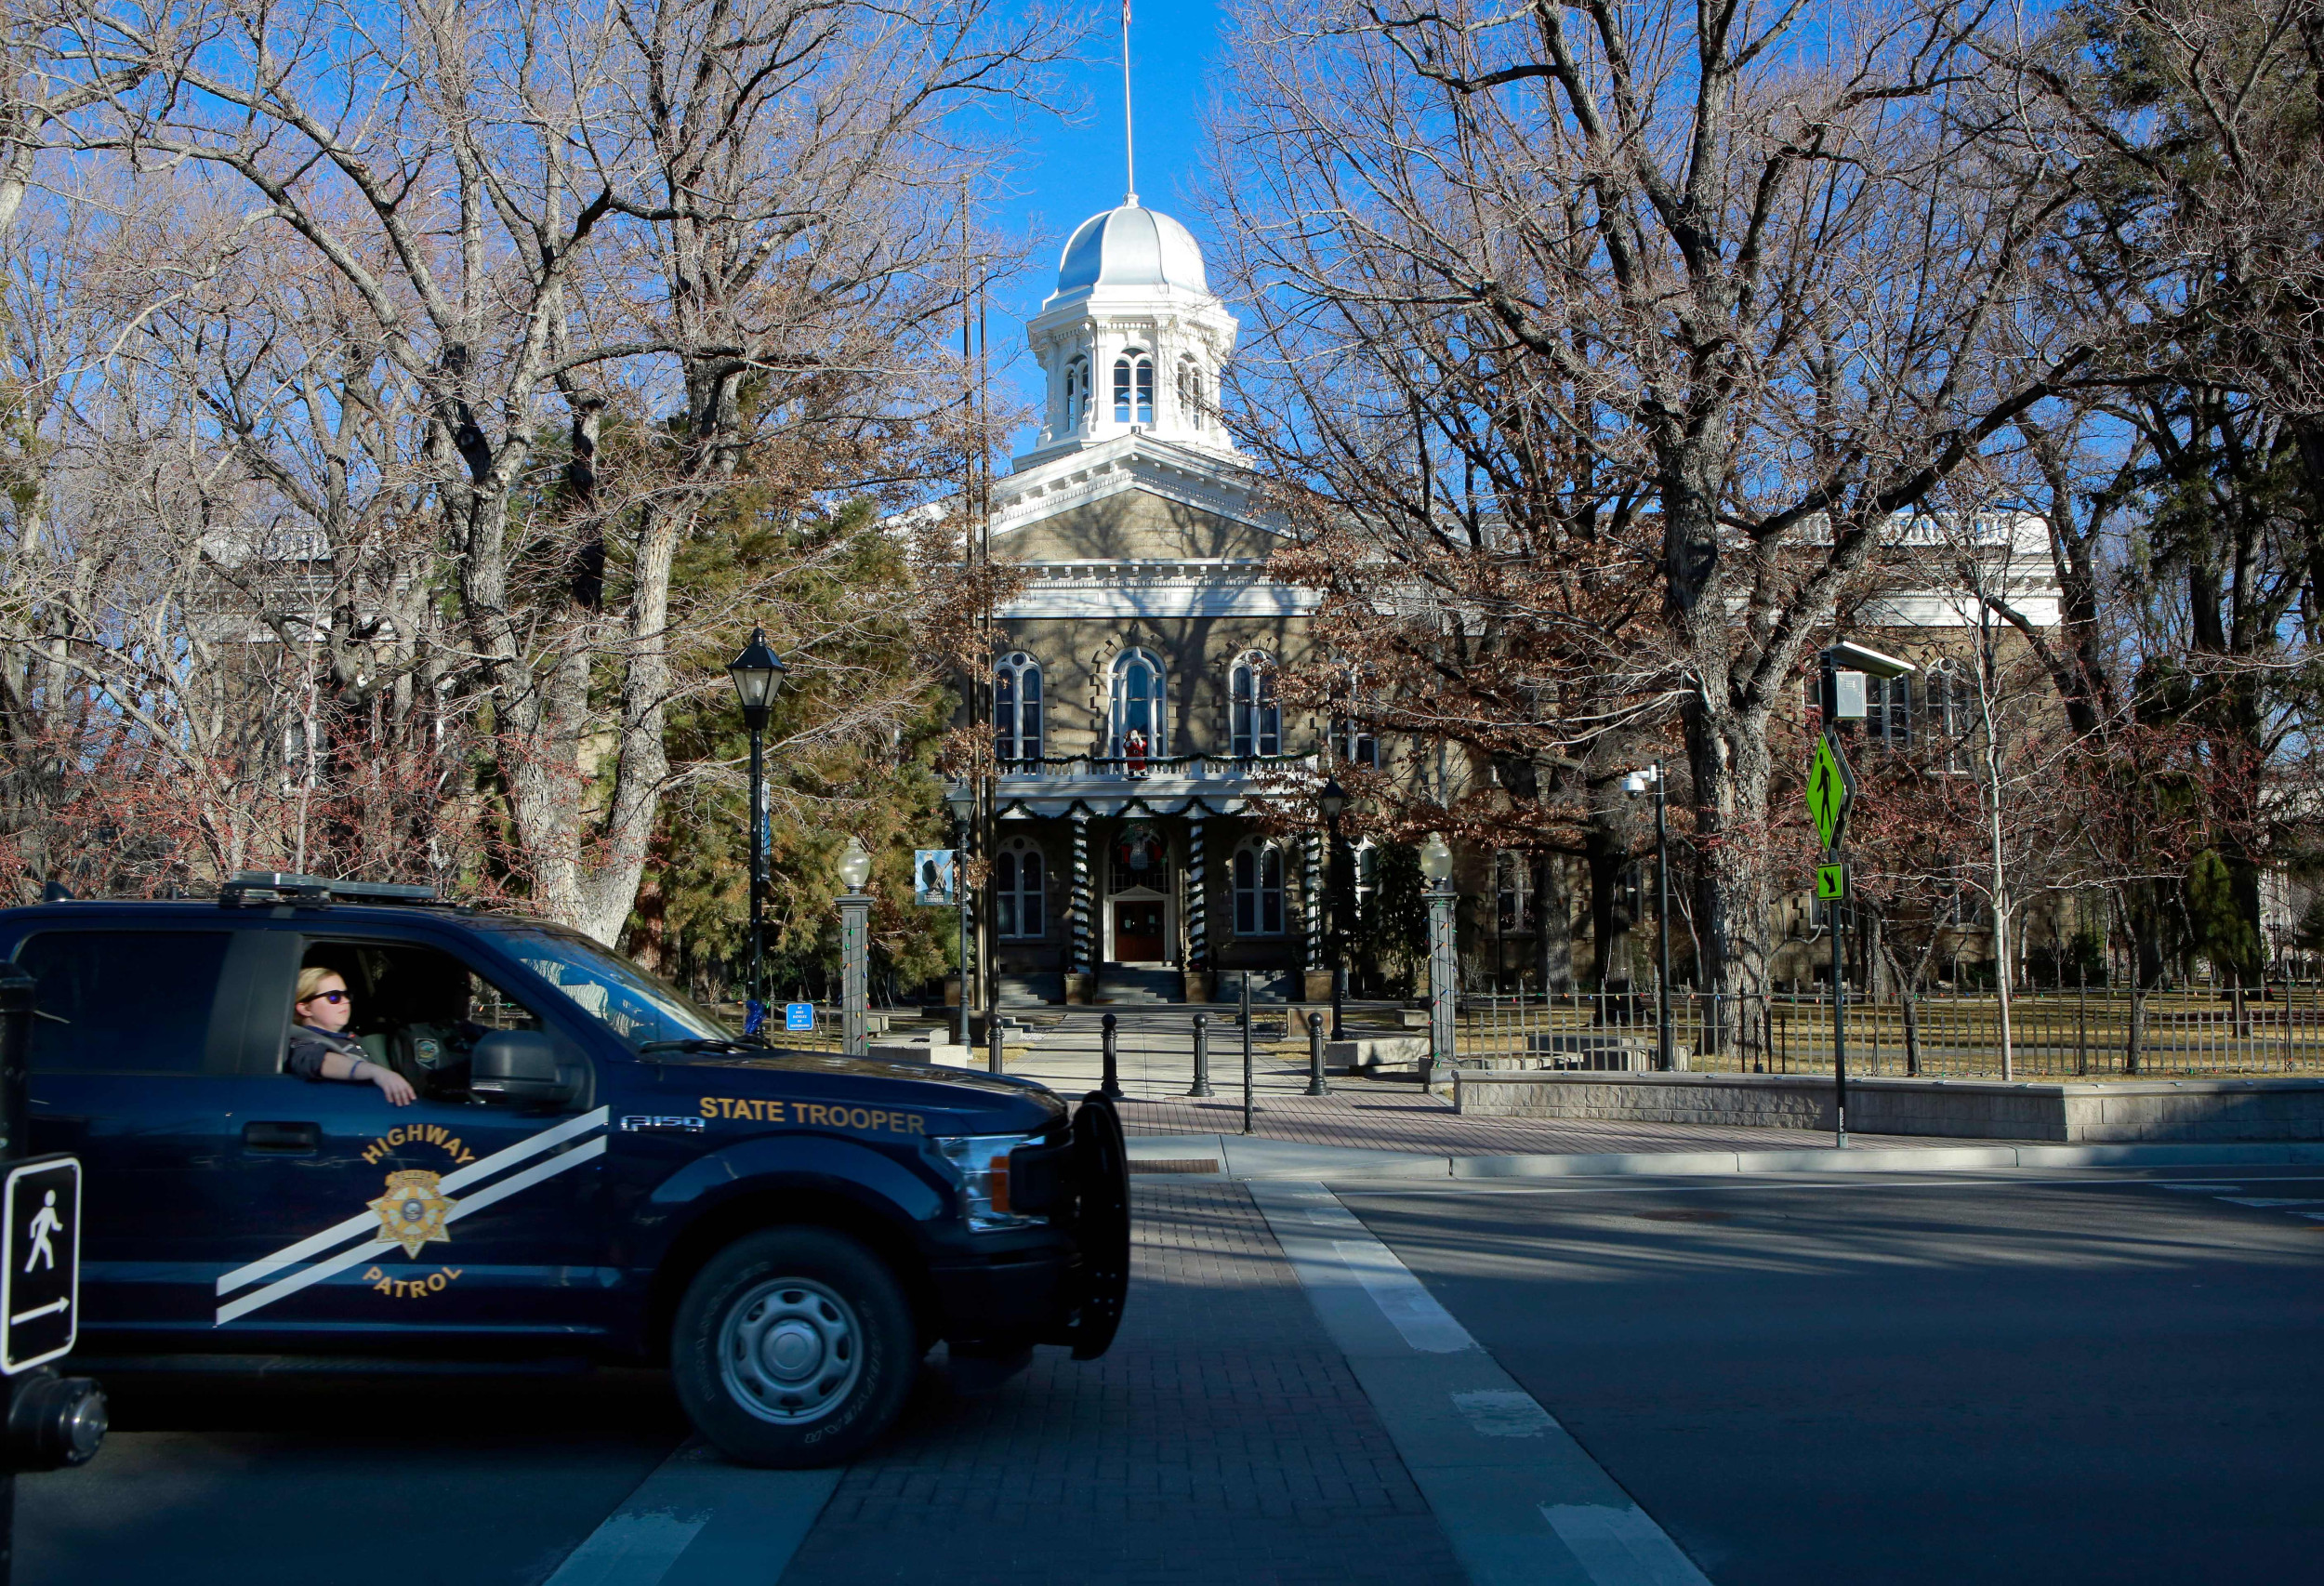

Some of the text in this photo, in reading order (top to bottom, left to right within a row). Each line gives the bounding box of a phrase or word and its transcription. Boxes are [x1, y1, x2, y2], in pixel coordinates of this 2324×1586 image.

[700, 1097, 926, 1135] STATE TROOPER
[361, 1124, 476, 1165] HIGHWAY
[362, 1266, 463, 1299] PATROL
